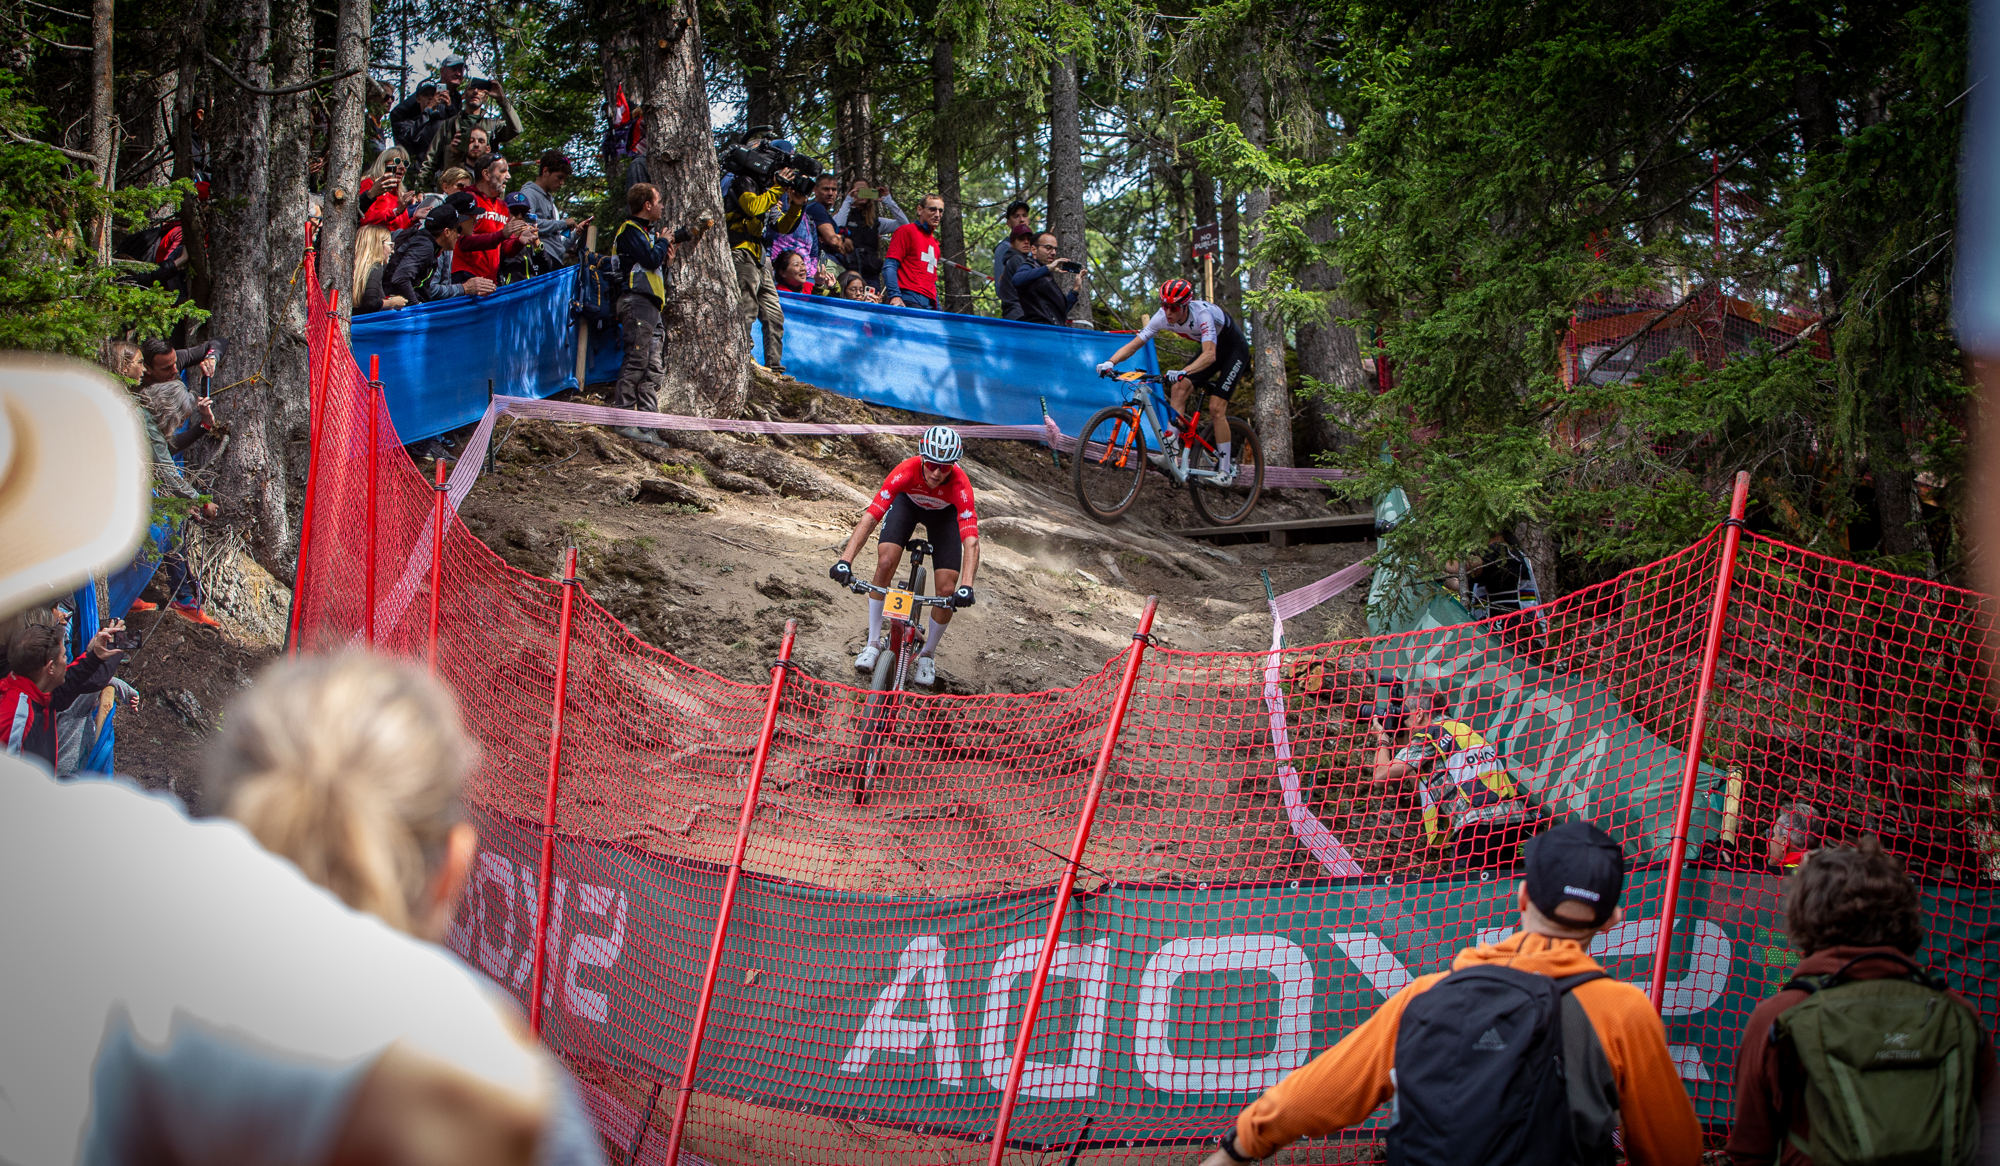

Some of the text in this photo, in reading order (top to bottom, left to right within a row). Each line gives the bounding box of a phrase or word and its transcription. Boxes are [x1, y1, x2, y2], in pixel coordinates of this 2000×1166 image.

[1201, 233, 1212, 241] NO
[1194, 238, 1218, 250] PUBLIC
[893, 597, 903, 610] 3
